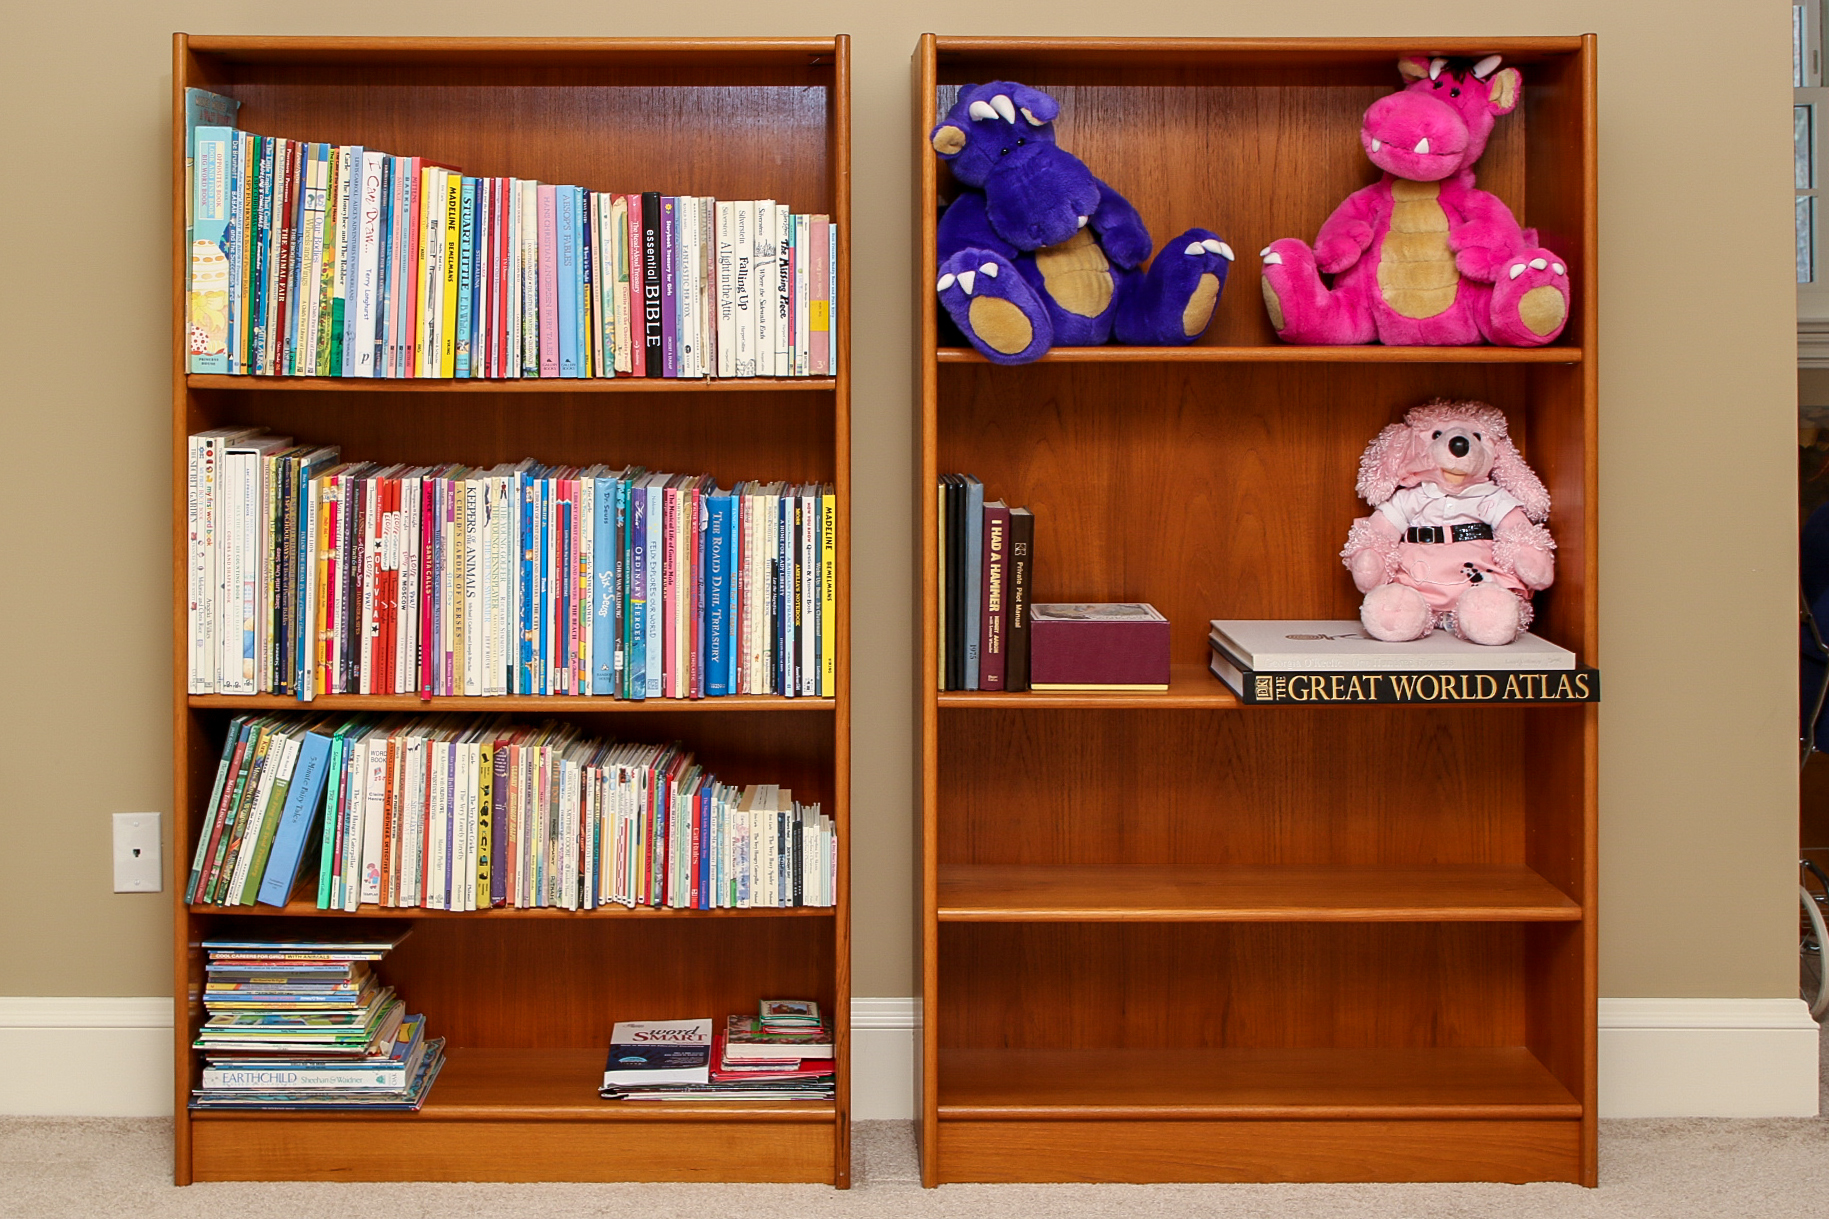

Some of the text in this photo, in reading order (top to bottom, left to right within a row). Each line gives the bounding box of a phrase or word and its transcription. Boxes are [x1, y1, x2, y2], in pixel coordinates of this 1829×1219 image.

[368, 159, 381, 171] I
[365, 176, 379, 203] Can
[563, 195, 572, 230] AESOP'S
[313, 217, 324, 262] Our Bodies
[461, 198, 472, 290] STUART LITTLE
[301, 218, 314, 286] Wheels and Wings
[718, 251, 732, 272] Light
[279, 248, 287, 280] ANIMAL
[737, 257, 749, 293] Falling
[778, 258, 789, 293] Missing
[646, 230, 660, 347] essential BIBLE
[722, 275, 731, 283] in
[363, 269, 372, 320] Terry Longhurst
[722, 285, 732, 299] the
[739, 295, 749, 310] Up
[722, 299, 732, 320] Attic
[780, 295, 789, 319] Piece
[460, 315, 468, 334] White
[205, 487, 212, 496] my
[467, 487, 476, 533] KEEPERS
[991, 527, 1002, 550] HAD
[991, 553, 1001, 561] A
[466, 547, 475, 598] ANIMALS
[599, 571, 612, 587] Six
[457, 584, 462, 595] OF
[711, 512, 722, 662] THE ROALD DAHL TREASURY
[990, 564, 1001, 611] HAMMER
[204, 598, 212, 618] Angela
[599, 594, 614, 617] Seuss
[1276, 674, 1590, 700] THE GREAT WORLD ATLAS
[292, 757, 317, 823] 5-Minute Fairy Tales
[350, 815, 358, 836] Hungry
[349, 838, 357, 868] Caterpillar
[633, 1032, 707, 1041] SMART
[650, 1026, 699, 1035] word
[223, 1073, 297, 1083] EARTHCHILD
